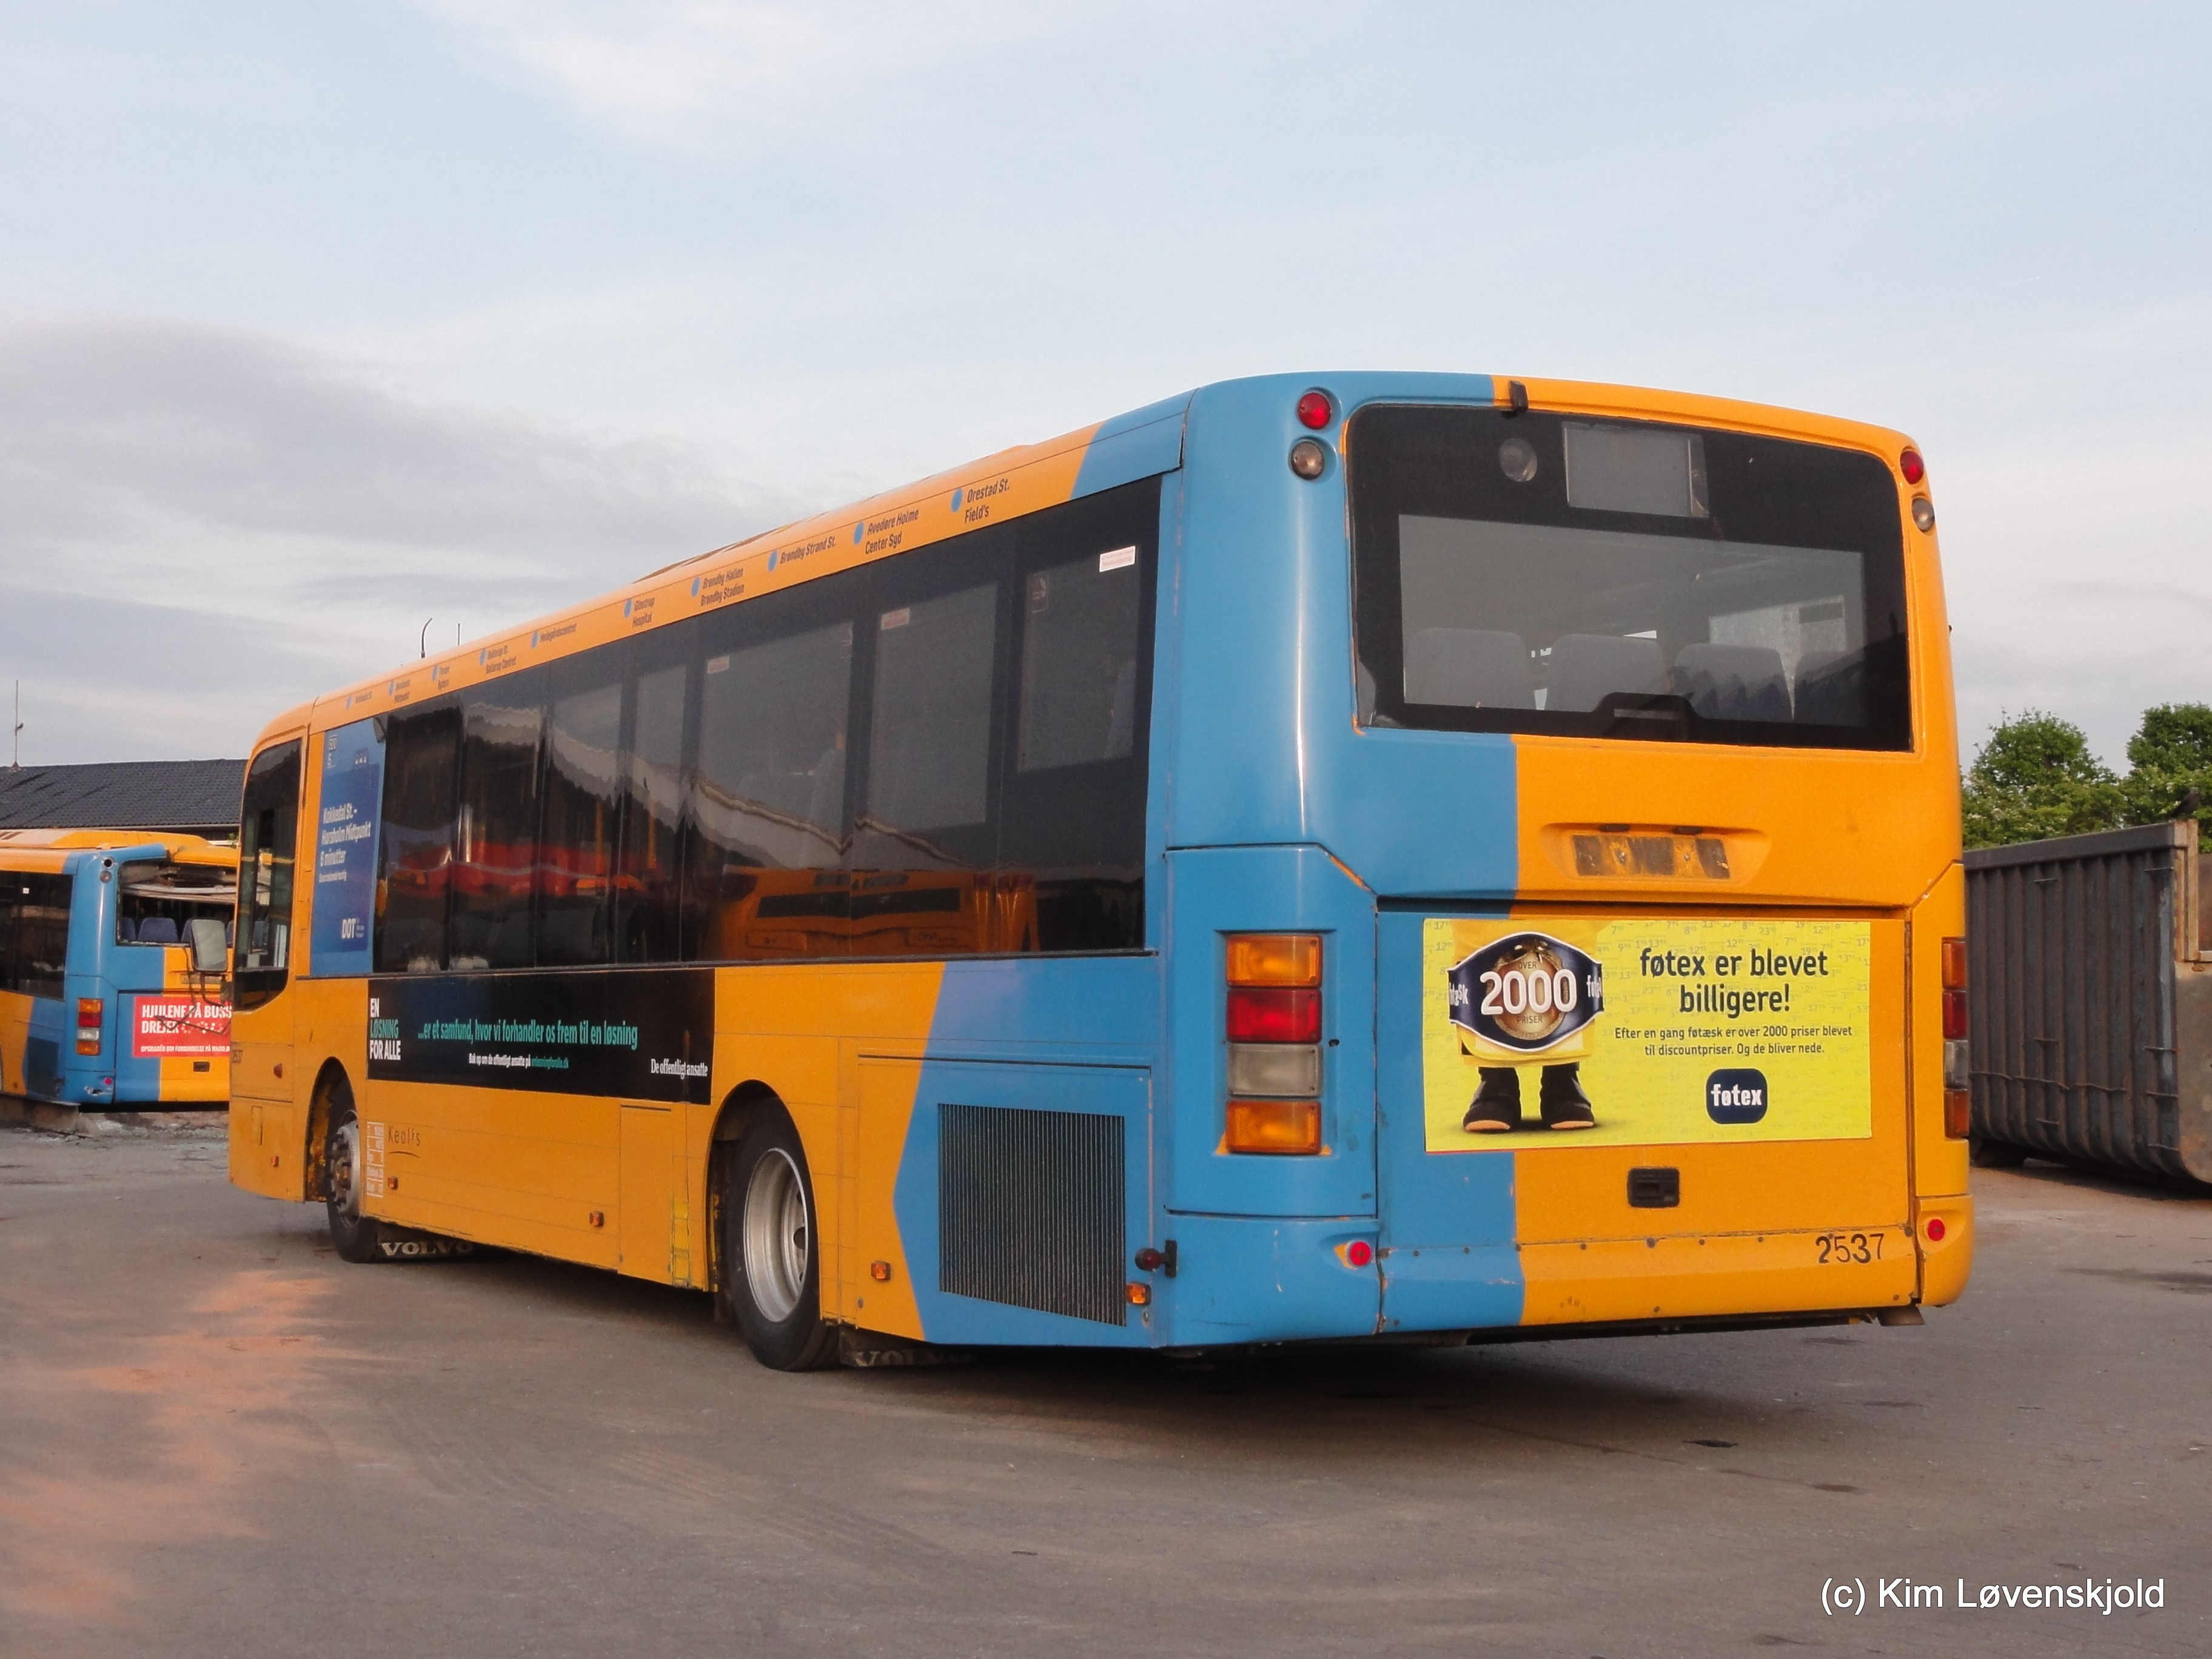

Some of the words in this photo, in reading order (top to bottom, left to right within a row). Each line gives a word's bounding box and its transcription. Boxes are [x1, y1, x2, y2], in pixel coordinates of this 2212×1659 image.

[999, 478, 1010, 493] St.
[897, 509, 919, 525] Holme
[965, 504, 989, 524] Field's
[806, 539, 828, 556] Strand
[865, 538, 888, 555] Center
[889, 531, 902, 549] Syd
[723, 584, 745, 599] Stadion
[632, 611, 652, 628] Hospital
[342, 918, 357, 939] DOT
[1518, 960, 1537, 970] OVER
[1640, 948, 1705, 977] føtex
[1715, 955, 1742, 976] er
[1750, 948, 1828, 976] blevet
[1480, 969, 1577, 1016] 2000
[1680, 983, 1789, 1018] billigere!
[142, 1005, 187, 1018] HJULENE
[189, 1002, 202, 1018] PÅ
[370, 997, 380, 1017] EN
[141, 1021, 179, 1034] DREJER
[370, 1019, 399, 1039] LØSNING
[1517, 1015, 1543, 1024] PRISER
[432, 1019, 440, 1039] et
[441, 1018, 474, 1045] samfund,
[475, 1019, 492, 1041] hvor
[494, 1019, 501, 1041] vi
[502, 1019, 545, 1043] forhandler
[546, 1025, 555, 1043] os
[557, 1019, 577, 1044] frem
[579, 1020, 589, 1045] til
[591, 1025, 602, 1045] en
[604, 1020, 638, 1051] løsning
[1615, 1027, 1641, 1039] Efter
[1660, 1030, 1684, 1041] gang
[1688, 1027, 1722, 1037] føtæsk
[1726, 1028, 1736, 1037] er
[1738, 1028, 1760, 1037] over
[1763, 1025, 1788, 1037] 2000
[1791, 1027, 1820, 1038] priser
[1823, 1025, 1852, 1036] blevet
[370, 1039, 383, 1059] FOR
[384, 1040, 401, 1061] ALLE
[1644, 1044, 1655, 1056] til
[1658, 1044, 1734, 1057] discountpriser.
[1737, 1043, 1750, 1056] Og
[1754, 1043, 1765, 1054] de
[1768, 1042, 1797, 1053] bliver
[1798, 1042, 1825, 1053] nede.
[651, 1058, 659, 1074] De
[660, 1058, 686, 1080] offentligt
[686, 1061, 708, 1078] ansatte
[1711, 1084, 1762, 1107] føtex
[388, 1126, 421, 1147] Keolis
[378, 1241, 474, 1256] VOLVO
[1815, 1233, 1885, 1264] 2537
